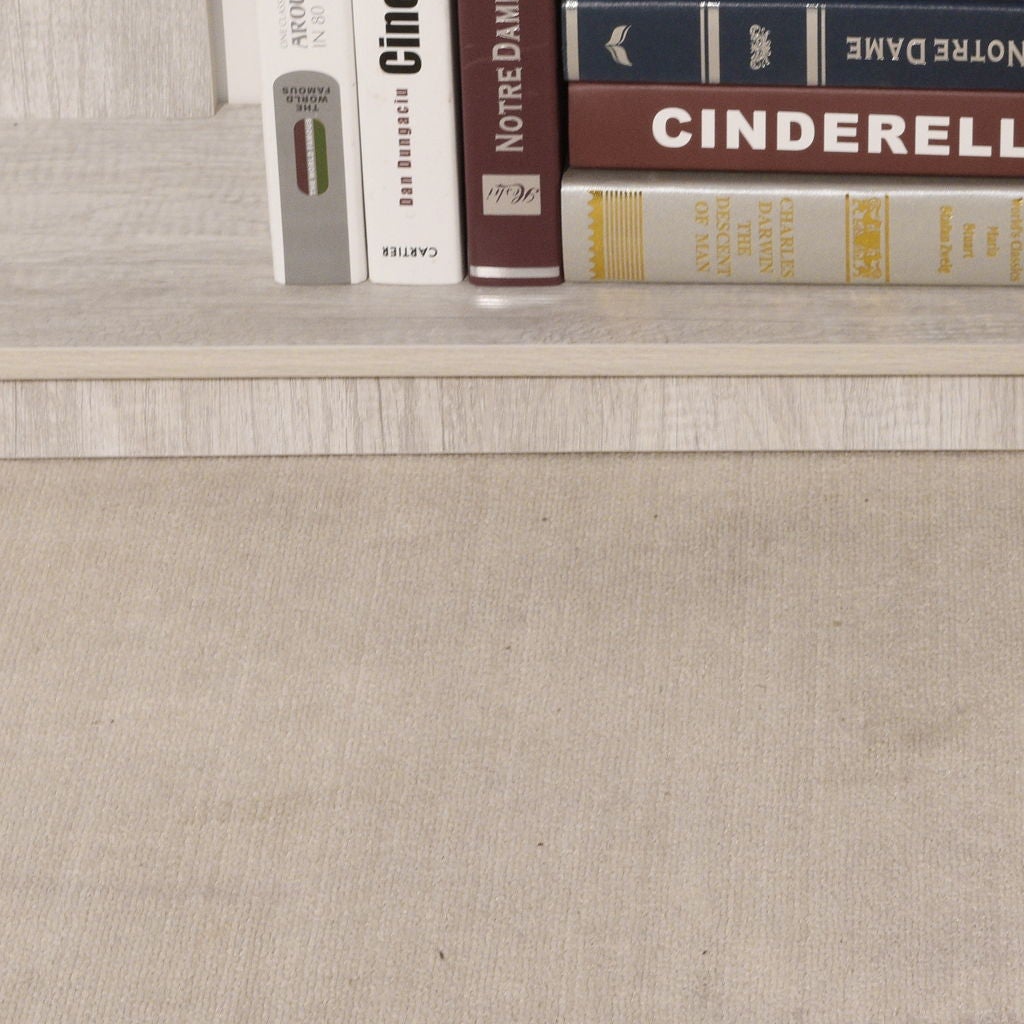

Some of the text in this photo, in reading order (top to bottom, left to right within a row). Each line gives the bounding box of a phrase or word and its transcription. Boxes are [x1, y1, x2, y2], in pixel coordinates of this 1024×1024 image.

[310, 5, 326, 25] 80
[312, 29, 327, 49] IN
[846, 36, 927, 66] DAME
[281, 86, 331, 95] FAMOUS
[286, 95, 329, 104] WORLD
[295, 104, 320, 113] THE
[495, 67, 524, 152] NOTRE
[394, 87, 414, 206] Dan Dungaciu
[382, 245, 438, 258] CARTIER
[695, 200, 711, 273] OF MAN
[716, 196, 732, 277] DESCENT
[737, 220, 752, 257] THE
[758, 201, 774, 273] DARWIN
[780, 197, 795, 278] CHARLES
